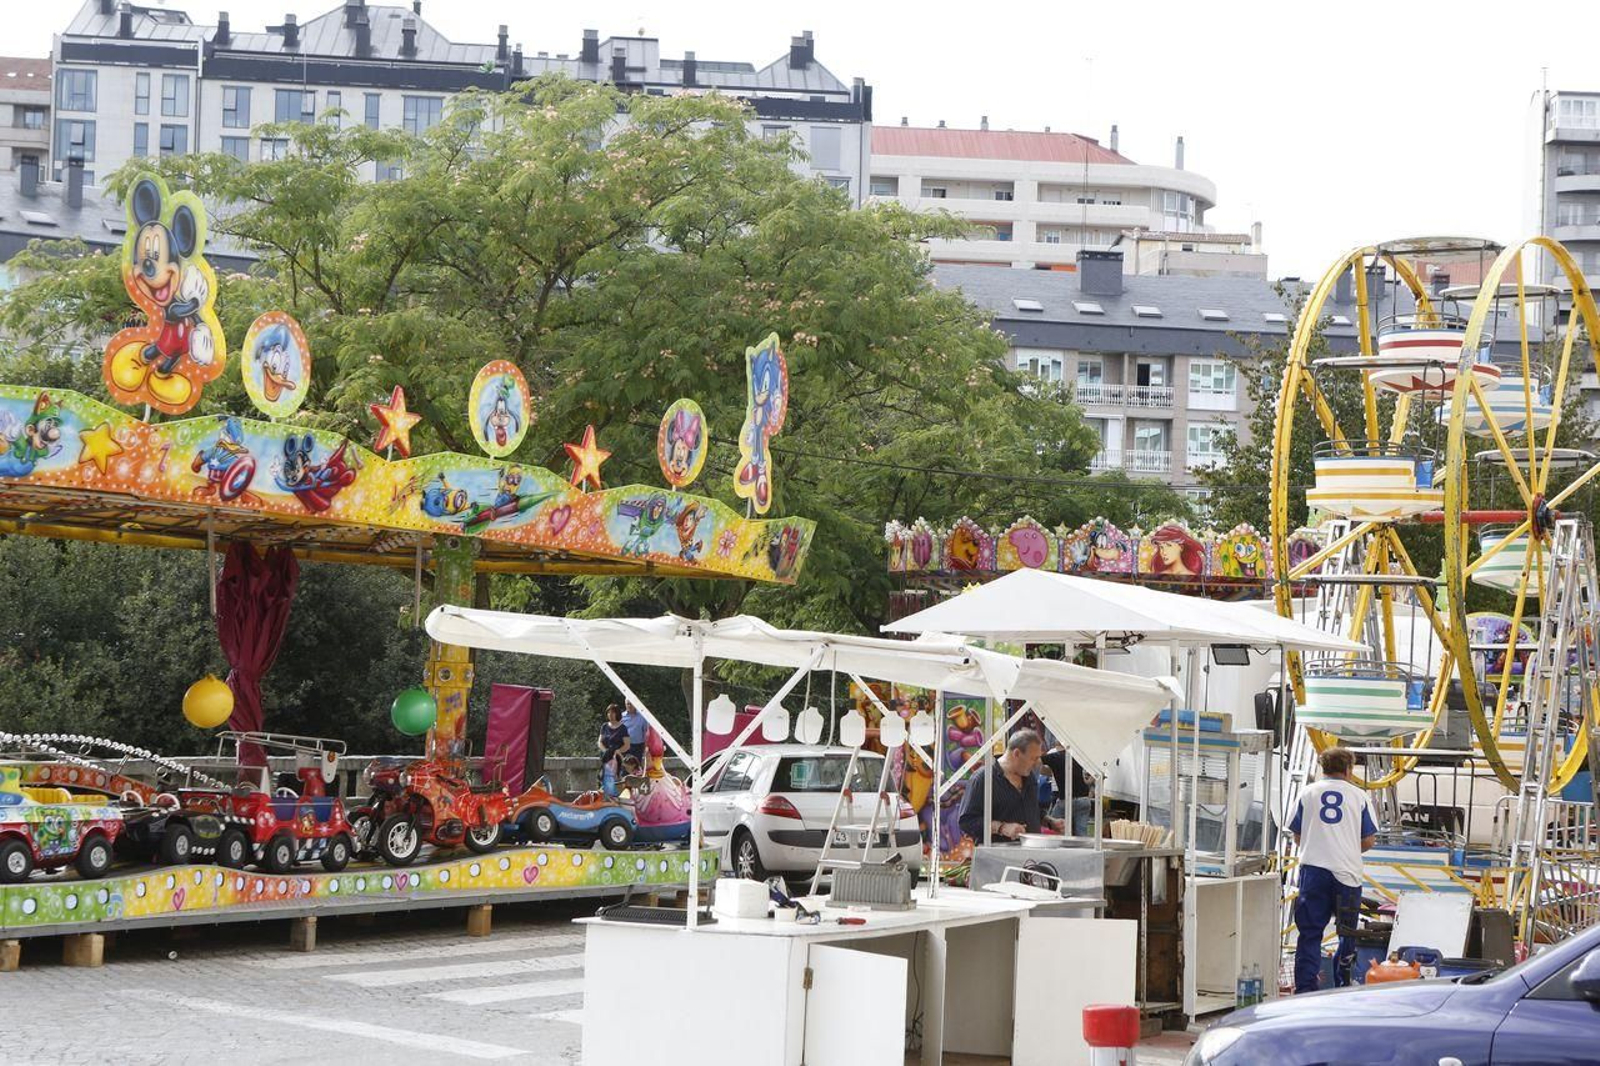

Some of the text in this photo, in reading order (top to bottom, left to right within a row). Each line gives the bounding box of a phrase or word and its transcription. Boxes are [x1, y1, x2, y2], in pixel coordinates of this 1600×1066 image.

[640, 782, 649, 794] 4
[1319, 790, 1344, 824] 8
[1399, 811, 1430, 823] AN
